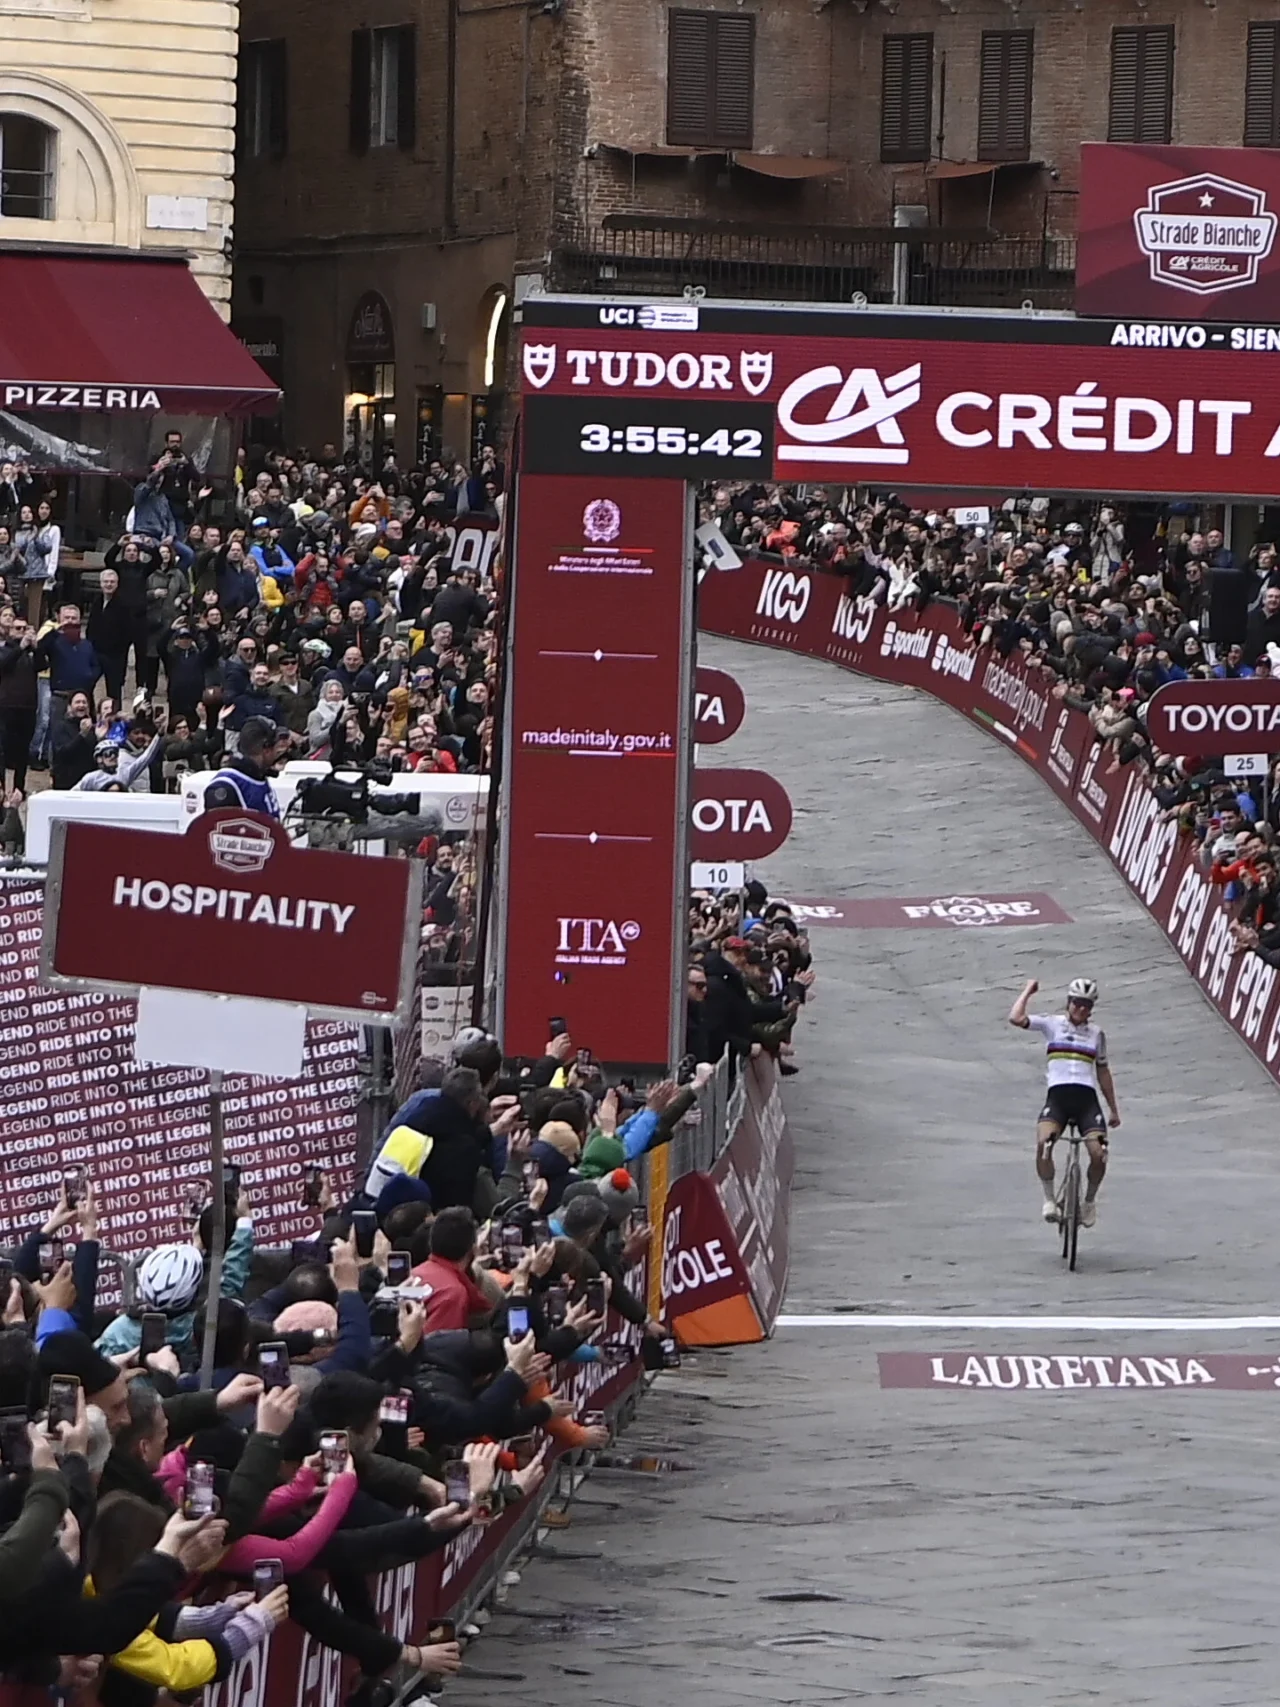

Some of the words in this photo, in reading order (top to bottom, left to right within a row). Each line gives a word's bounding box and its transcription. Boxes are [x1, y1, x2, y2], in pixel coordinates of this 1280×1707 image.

[1150, 220, 1198, 245] Strade
[1203, 222, 1262, 247] Bianche
[1190, 255, 1226, 265] CRÉDIT
[1190, 263, 1239, 272] AGRICOLE
[599, 308, 635, 325] UCI
[1111, 323, 1206, 347] ARRIVO
[566, 349, 733, 390] TUDOR
[5, 384, 161, 410] PIZZERIA
[935, 382, 1253, 456] CRÉDIT
[580, 424, 763, 457] 3:55:42
[965, 511, 980, 522] 50
[522, 727, 672, 751] madeinitaly.gov.it
[1236, 757, 1255, 771] 25
[708, 868, 729, 884] 10
[113, 875, 355, 935] HOSPITALITY
[902, 900, 1041, 920] FIORE
[1167, 863, 1214, 961] enel
[556, 917, 627, 953] ITA
[31, 997, 66, 1016] RIDE
[67, 990, 104, 1009] INTO
[1229, 950, 1278, 1043] enel
[35, 1016, 66, 1035] RIDE
[69, 1009, 104, 1028] INTO
[107, 1003, 134, 1021] THE
[39, 1034, 73, 1053] RIDE
[74, 1026, 111, 1046] INTO
[42, 1053, 73, 1072] RIDE
[77, 1045, 111, 1065] INTO
[46, 1070, 79, 1090] RIDE
[82, 1062, 118, 1083] INTO
[120, 1056, 150, 1075] THE
[50, 1089, 81, 1108] RIDE
[84, 1082, 118, 1101] INTO
[121, 1076, 148, 1094] THE
[151, 1065, 206, 1088] LEGEND
[251, 1088, 288, 1108] INTO
[288, 1082, 318, 1101] THE
[53, 1107, 87, 1127] RIDE
[89, 1099, 126, 1119] INTO
[127, 1093, 156, 1112] THE
[224, 1112, 256, 1132] RIDE
[258, 1105, 292, 1125] INTO
[294, 1099, 320, 1118] THE
[0, 1132, 55, 1156] LEGEND
[57, 1125, 88, 1145] RIDE
[92, 1118, 126, 1138] INTO
[129, 1112, 155, 1130] THE
[222, 1131, 256, 1151] RIDE
[258, 1124, 294, 1144] INTO
[295, 1117, 325, 1137] THE
[3, 1150, 58, 1174] LEGEND
[61, 1143, 95, 1163] RIDE
[97, 1136, 133, 1156] INTO
[135, 1130, 163, 1148] THE
[231, 1149, 263, 1168] RIDE
[265, 1141, 299, 1162] INTO
[302, 1136, 329, 1154] THE
[6, 1168, 62, 1192] LEGEND
[99, 1155, 133, 1174] INTO
[136, 1149, 162, 1167] THE
[103, 1172, 140, 1192] INTO
[142, 1166, 171, 1185] THE
[106, 1191, 140, 1211] INTO
[143, 1185, 170, 1204] THE
[111, 1209, 147, 1229] INTO
[149, 1203, 178, 1221] THE
[114, 1228, 146, 1247] INTO
[150, 1222, 177, 1240] THE
[930, 1355, 1216, 1389] LAURETANA
